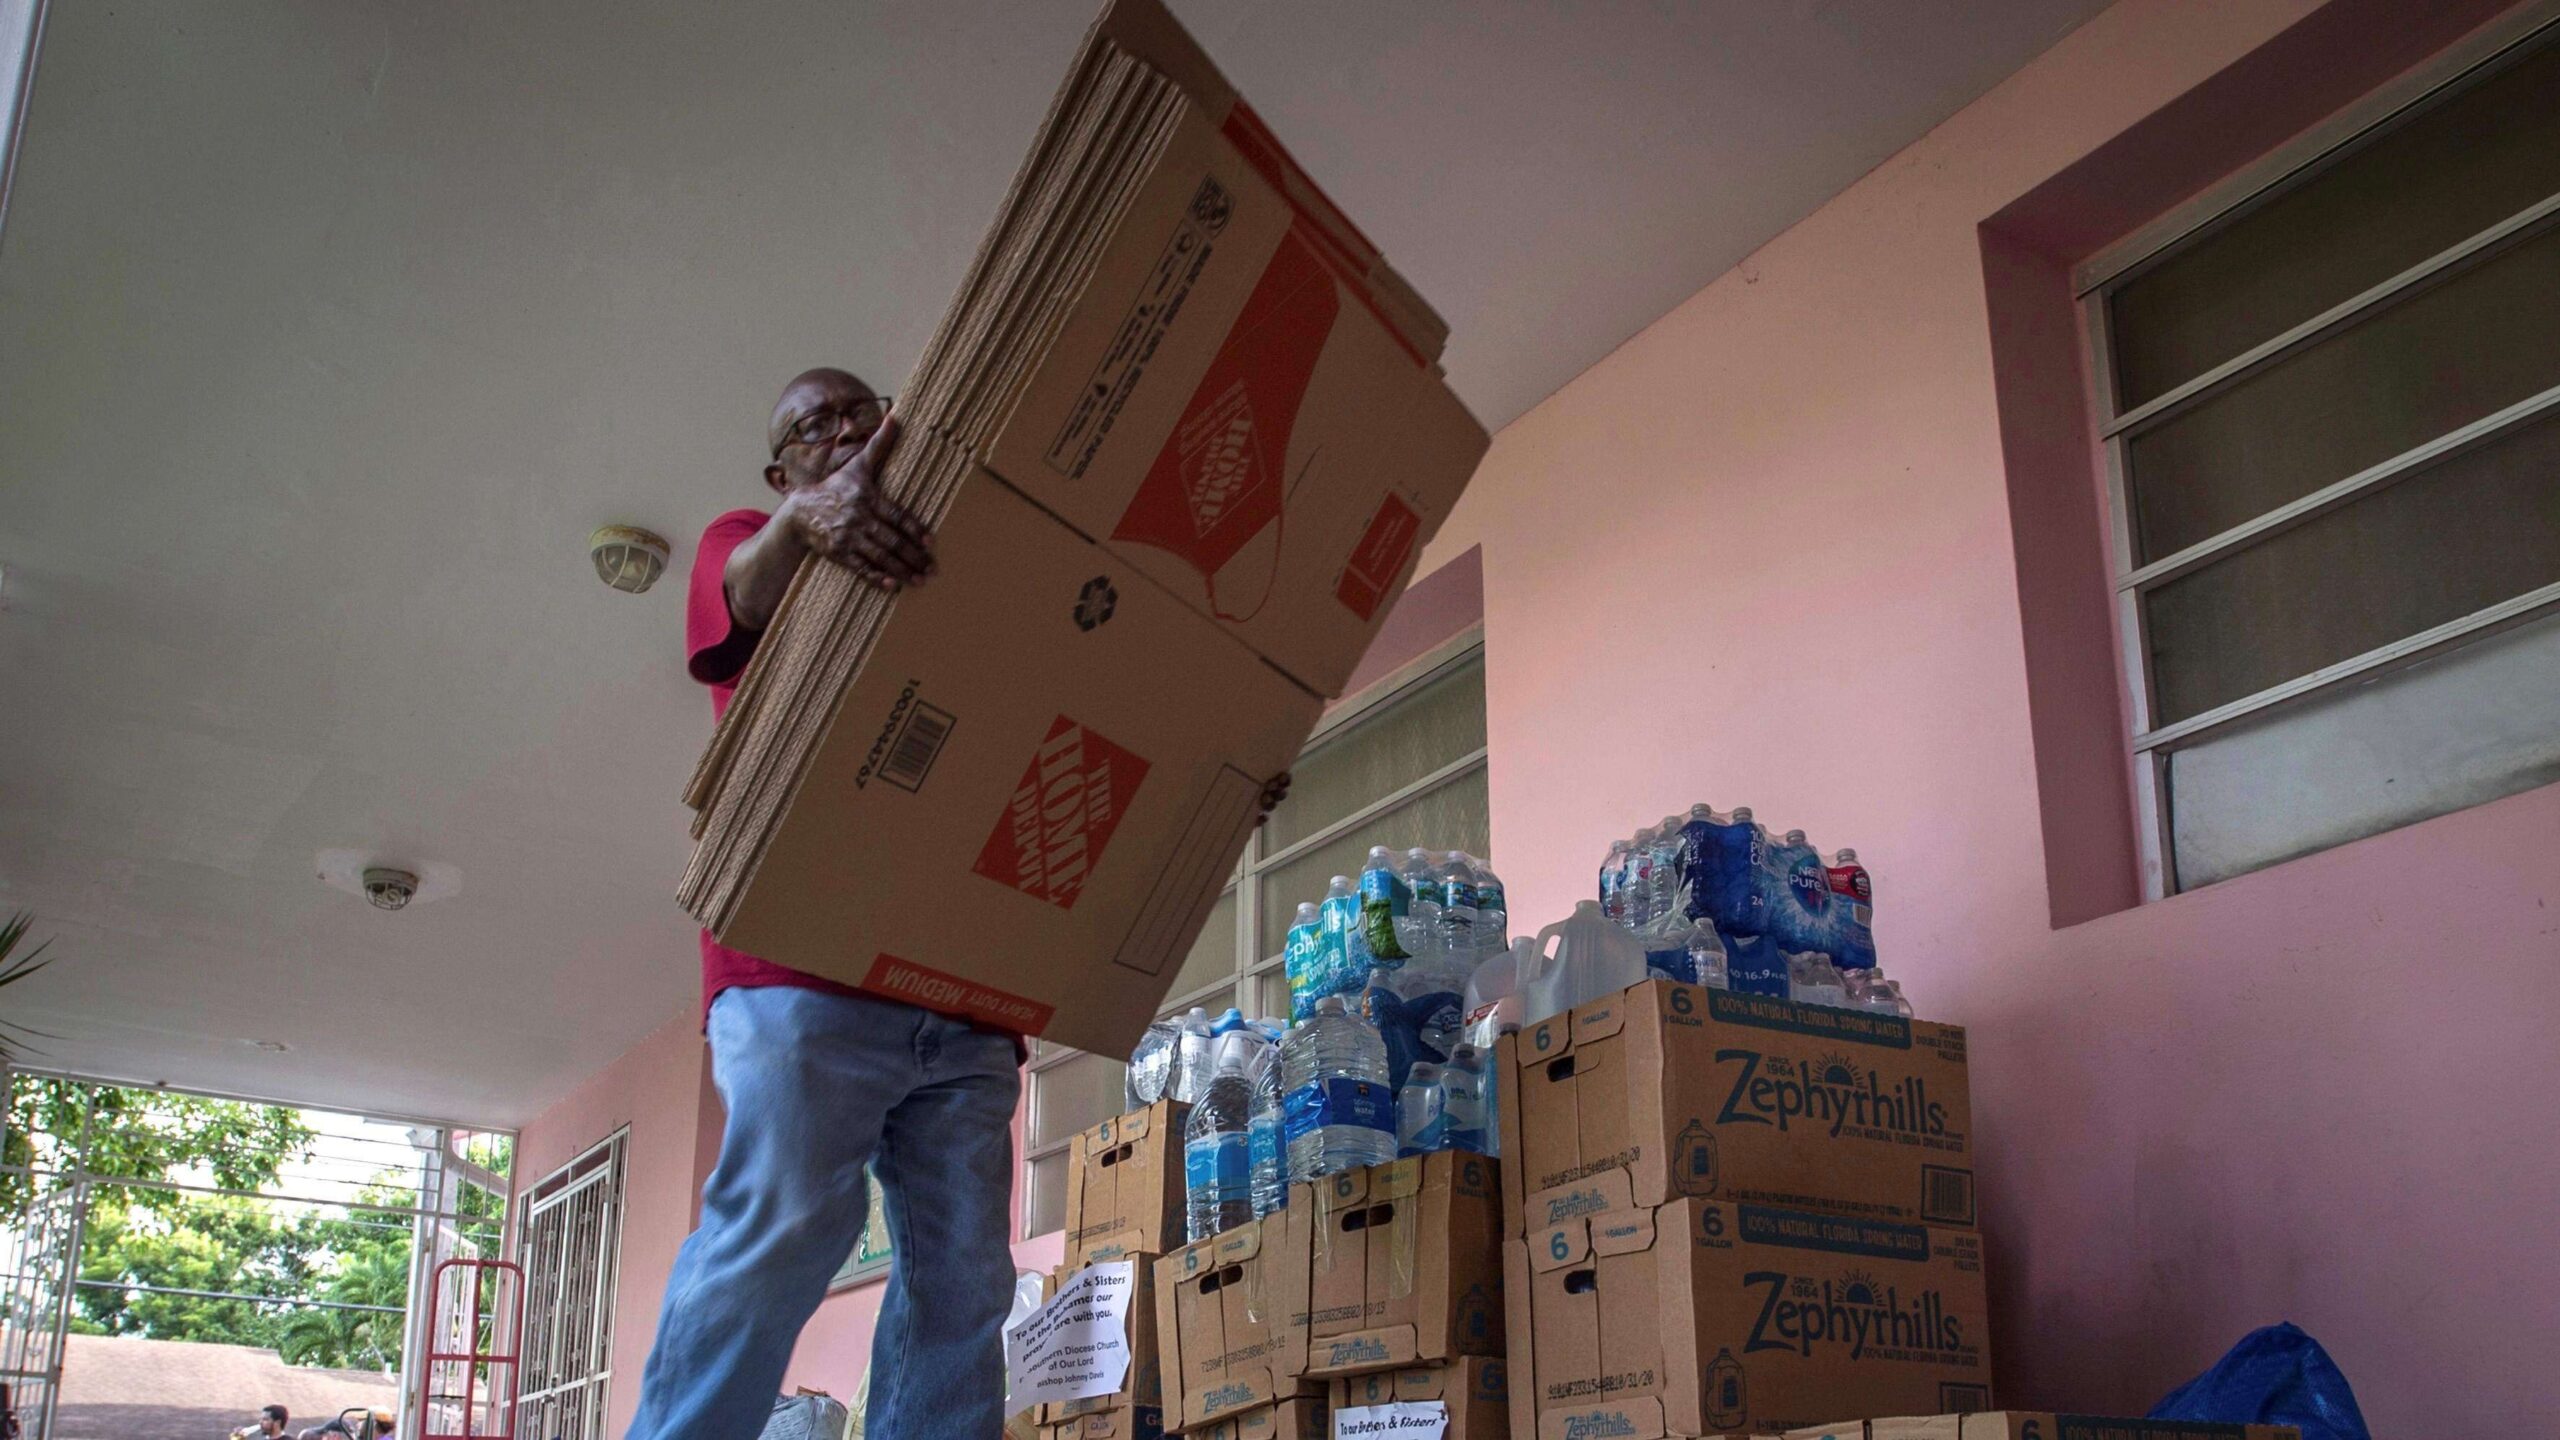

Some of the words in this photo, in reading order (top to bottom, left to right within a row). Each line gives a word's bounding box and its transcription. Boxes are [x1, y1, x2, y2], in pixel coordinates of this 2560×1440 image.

[1197, 419, 1251, 528] HOME
[856, 679, 921, 790] 1003944767
[1087, 760, 1111, 830] THE
[1039, 722, 1089, 904] HOME
[1011, 779, 1044, 892] DEPOT
[883, 965, 967, 1006] MEDIUM
[1744, 969, 1770, 981] 16.9
[966, 989, 1001, 1011] DUTY
[1001, 1000, 1038, 1021] HEAVY
[1670, 987, 1693, 1014] 6
[1670, 1015, 1703, 1027] GALLON
[1716, 998, 1749, 1015] 100%
[1750, 1000, 1793, 1023] NATURAL
[1796, 1008, 1836, 1029] FLORIDA
[1840, 1015, 1873, 1034] SPRING
[1875, 1019, 1905, 1038] WATER
[1536, 1024, 1551, 1051] 6
[1766, 1063, 1795, 1077] 1964
[1715, 1050, 1945, 1138] Zephyrhills
[1337, 1173, 1352, 1197] 6
[1464, 1161, 1483, 1186] 6
[1703, 1207, 1723, 1236] 6
[1748, 1215, 1776, 1232] 100%
[1778, 1218, 1819, 1239] NATURAL
[1823, 1225, 1859, 1241] FLORIDA
[1864, 1229, 1894, 1246] SPRING
[1896, 1233, 1922, 1249] WATER
[1551, 1232, 1569, 1260] 6
[1701, 1238, 1733, 1249] GALLON
[1185, 1248, 1197, 1270] 6
[1790, 1285, 1818, 1298] 1964
[1016, 1330, 1027, 1340] To
[1029, 1317, 1044, 1331] our
[1046, 1285, 1080, 1318] Brothers
[1082, 1278, 1092, 1288] &
[1095, 1276, 1125, 1285] Sisters
[1026, 1336, 1035, 1347] in
[1037, 1324, 1052, 1338] the
[1096, 1293, 1113, 1302] our
[1054, 1317, 1070, 1331] are
[1073, 1311, 1094, 1323] with
[1095, 1310, 1112, 1322] you.
[1743, 1271, 1960, 1361] Zephyrhills
[1065, 1343, 1096, 1355] Diocese
[1097, 1338, 1119, 1350] Church
[1329, 1338, 1386, 1366] Zephyrhills
[1048, 1361, 1057, 1371] of
[1059, 1360, 1075, 1368] Our
[1077, 1357, 1094, 1366] Lord
[1064, 1373, 1088, 1384] Johnny
[1089, 1371, 1104, 1380] Davis
[1203, 1382, 1250, 1414] Zephyrhills
[1366, 1376, 1378, 1400] 6
[1341, 1422, 1347, 1436] To
[1348, 1423, 1357, 1435] our
[1388, 1415, 1398, 1429] &
[1400, 1416, 1437, 1428] Sisters
[1564, 1411, 1630, 1440] Zephyrhills
